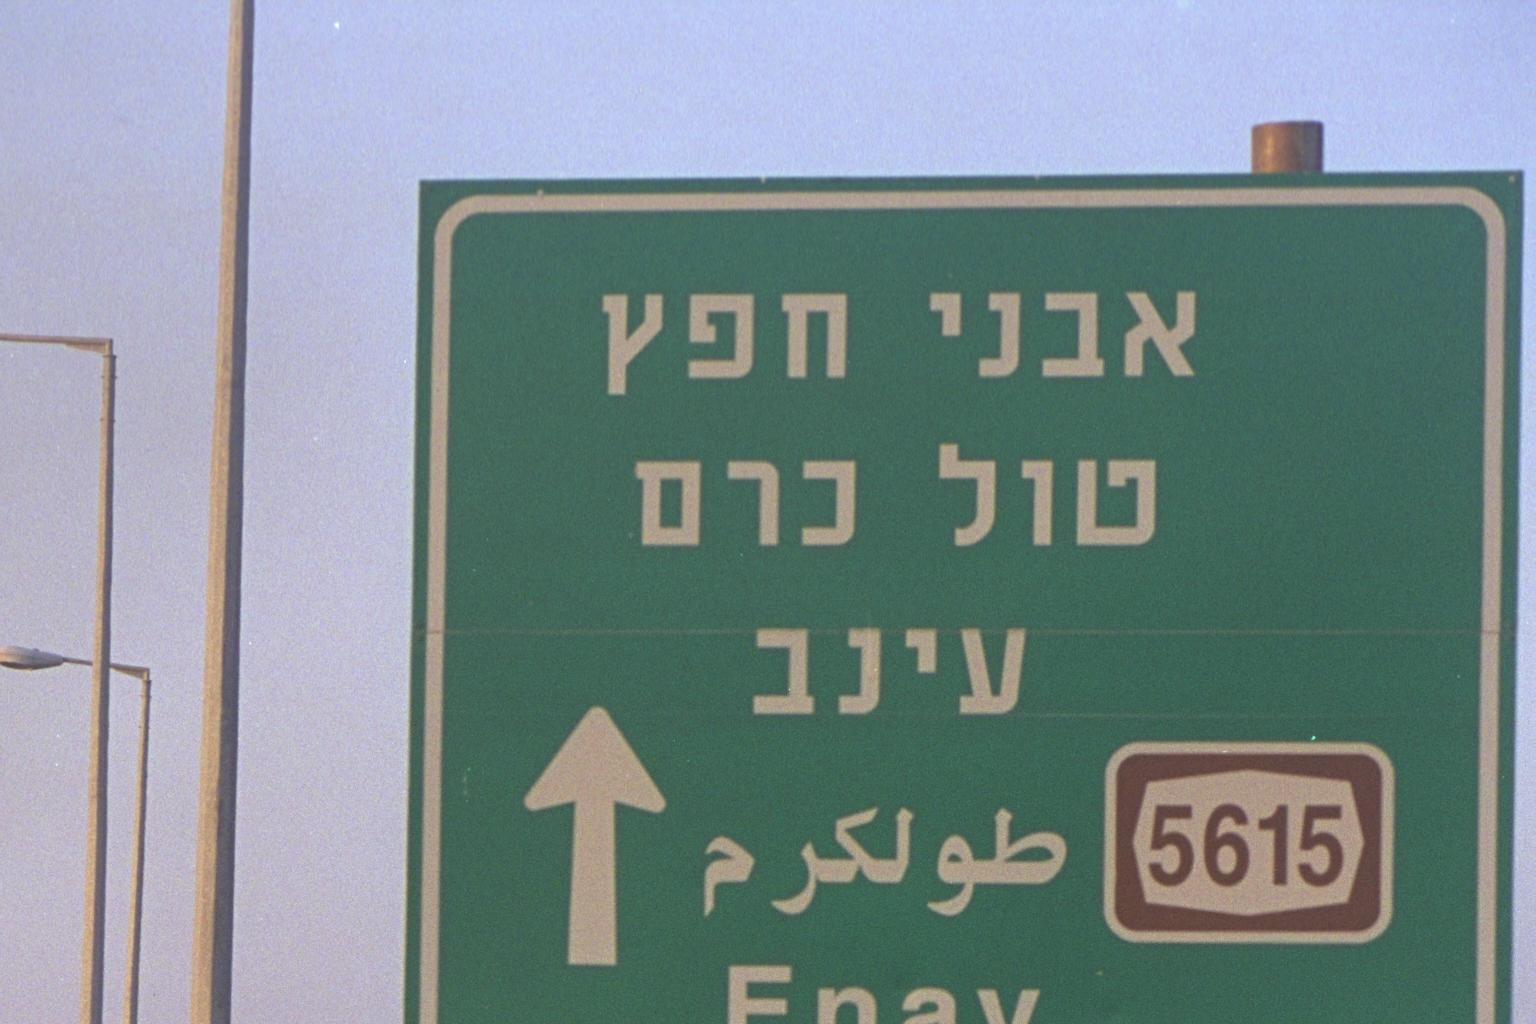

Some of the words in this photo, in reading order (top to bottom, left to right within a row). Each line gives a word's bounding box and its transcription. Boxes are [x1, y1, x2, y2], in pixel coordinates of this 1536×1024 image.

[602, 293, 848, 395] חפץ
[929, 291, 1196, 377] אבני
[634, 460, 856, 546] כרם
[939, 443, 1156, 546] טול
[753, 627, 1026, 715] עינב
[1147, 804, 1345, 887] 5615
